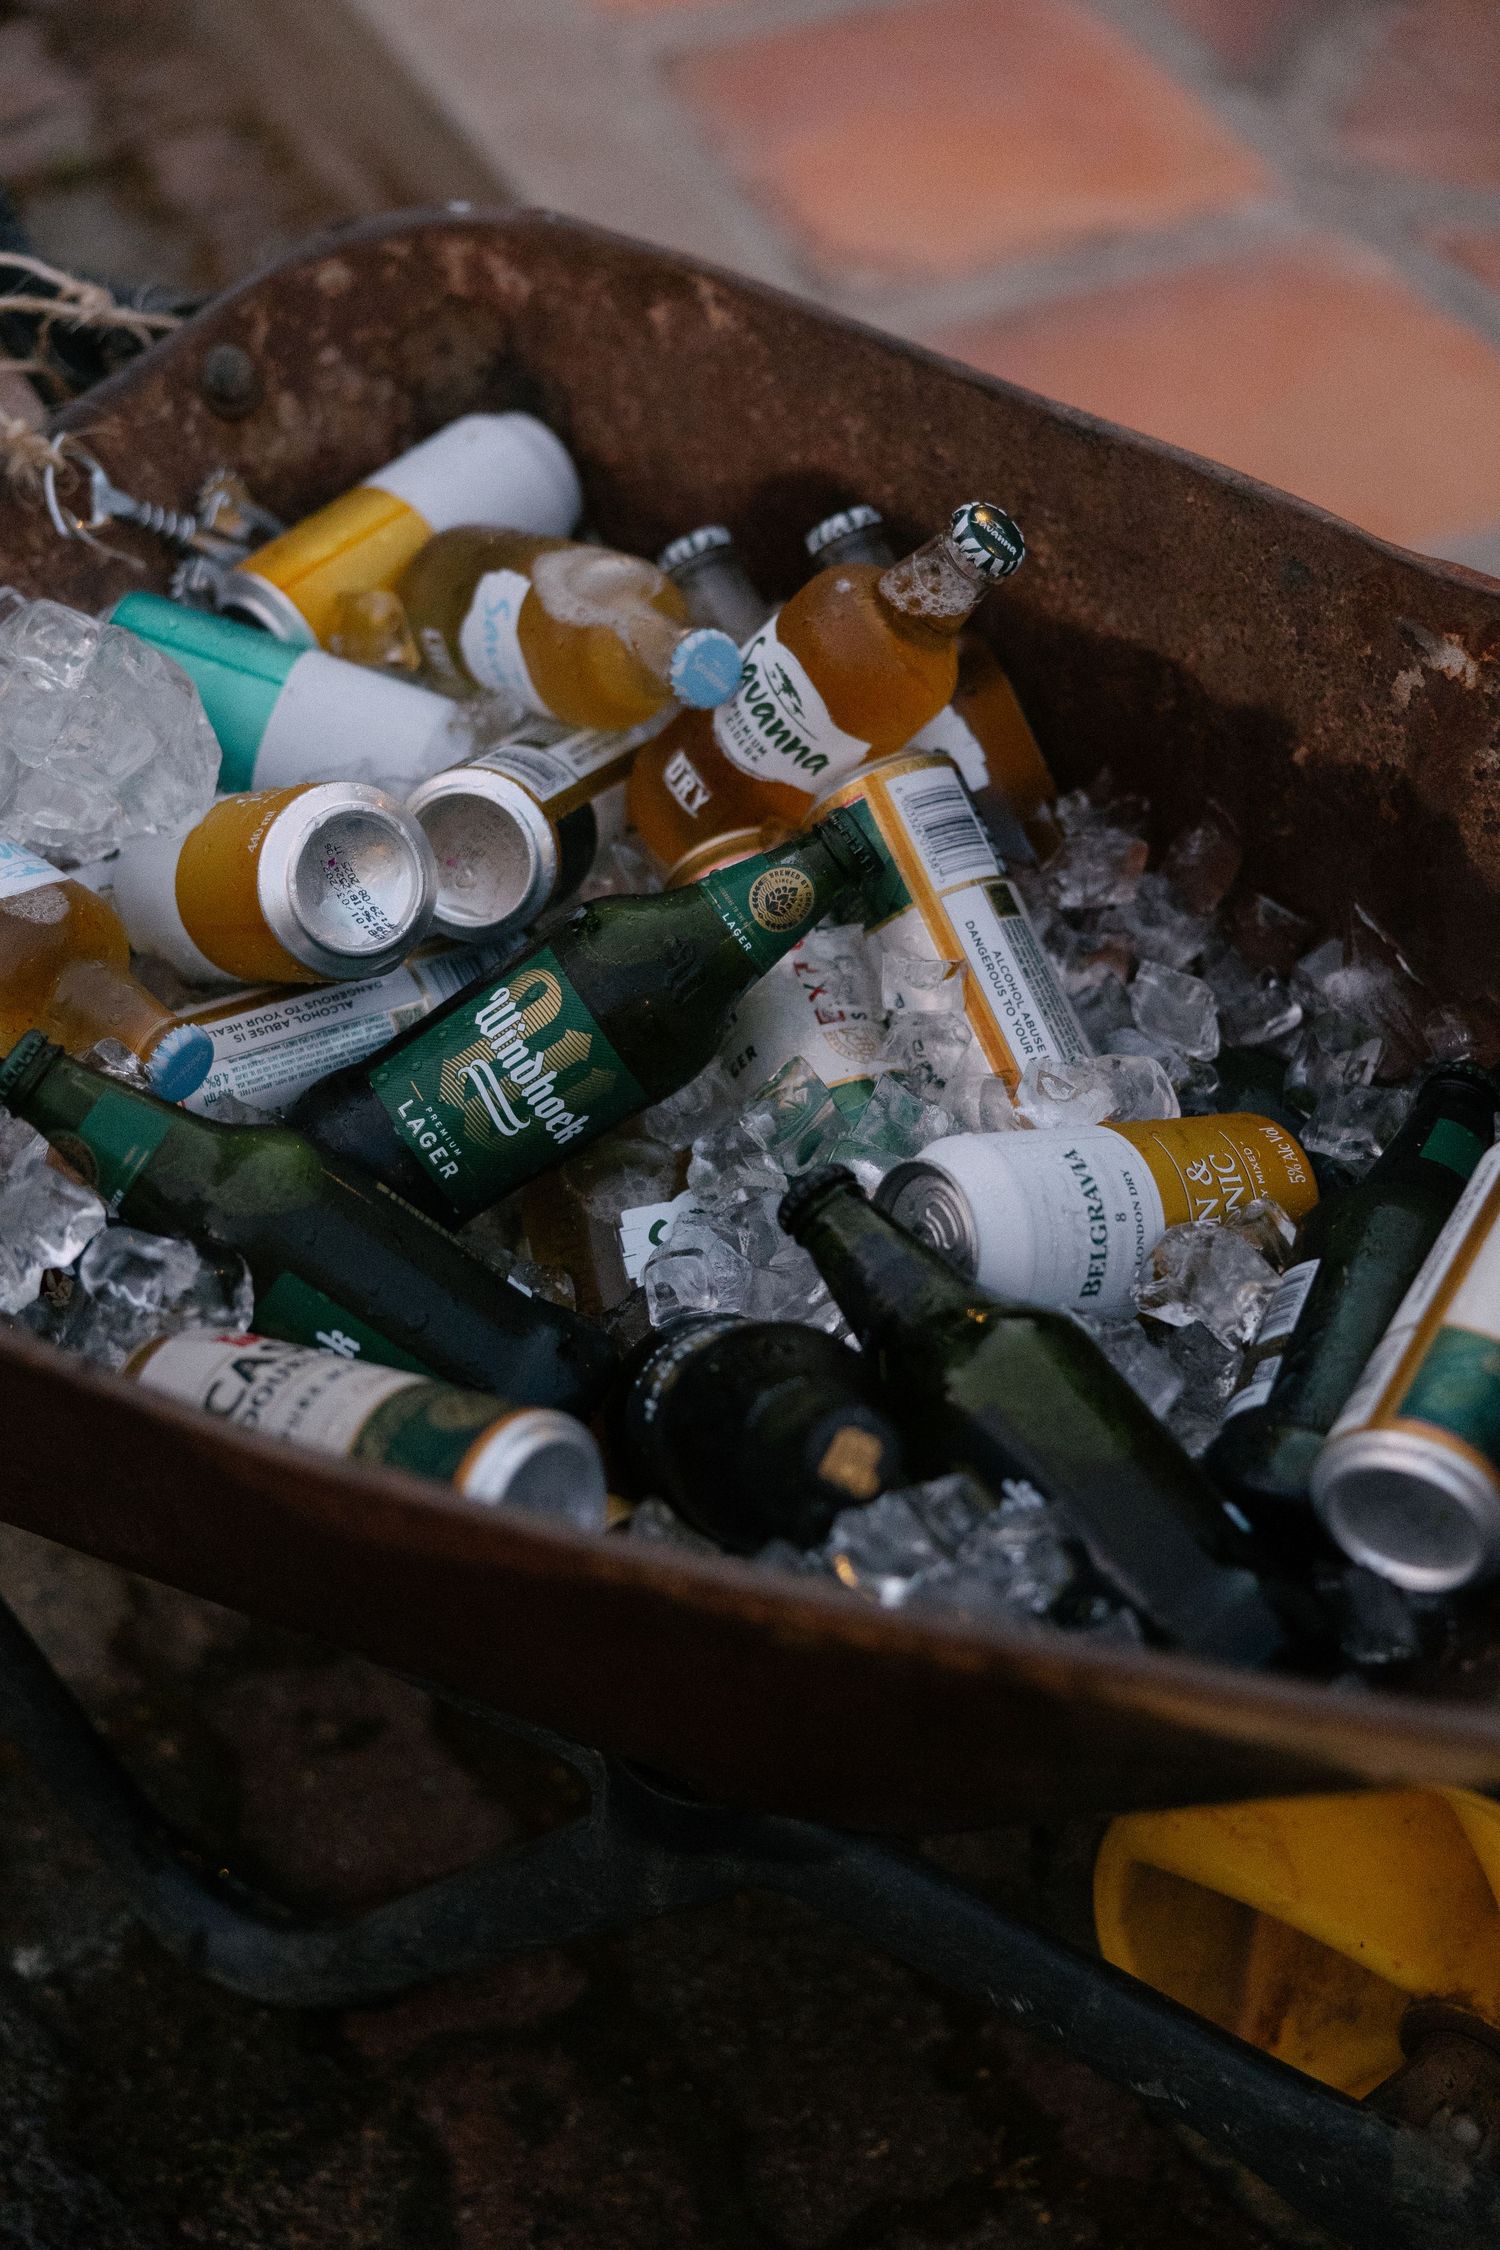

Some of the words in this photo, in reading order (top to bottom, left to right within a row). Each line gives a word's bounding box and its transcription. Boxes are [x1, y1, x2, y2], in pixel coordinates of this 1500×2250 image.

[721, 912, 752, 951] LAGER
[305, 979, 384, 1012] DANGEROUS
[965, 920, 1007, 998] DANGEROUS
[1002, 999, 1016, 1017] TO
[1011, 1019, 1034, 1055] YOUR
[992, 950, 1025, 1010] ALCOHOL
[1021, 1011, 1046, 1054] ABUSE
[248, 1011, 284, 1029] YOUR
[284, 1004, 304, 1017] TO
[296, 1000, 354, 1023] ALCOHOL
[207, 1021, 244, 1038] HEAL
[233, 1032, 247, 1043] IS
[249, 1019, 290, 1040] ABUSE
[475, 986, 590, 1145] Windhoek
[397, 1099, 460, 1180] LAGER
[425, 1106, 462, 1157] PREMIUM
[1259, 1126, 1284, 1143] Vol
[1277, 1143, 1299, 1162] Alc
[1120, 1169, 1139, 1197] DRY
[1208, 1151, 1245, 1213] NIC
[1286, 1163, 1307, 1185] 5%
[1063, 1148, 1108, 1299] BELGRAVIA
[1132, 1200, 1145, 1267] LONDON
